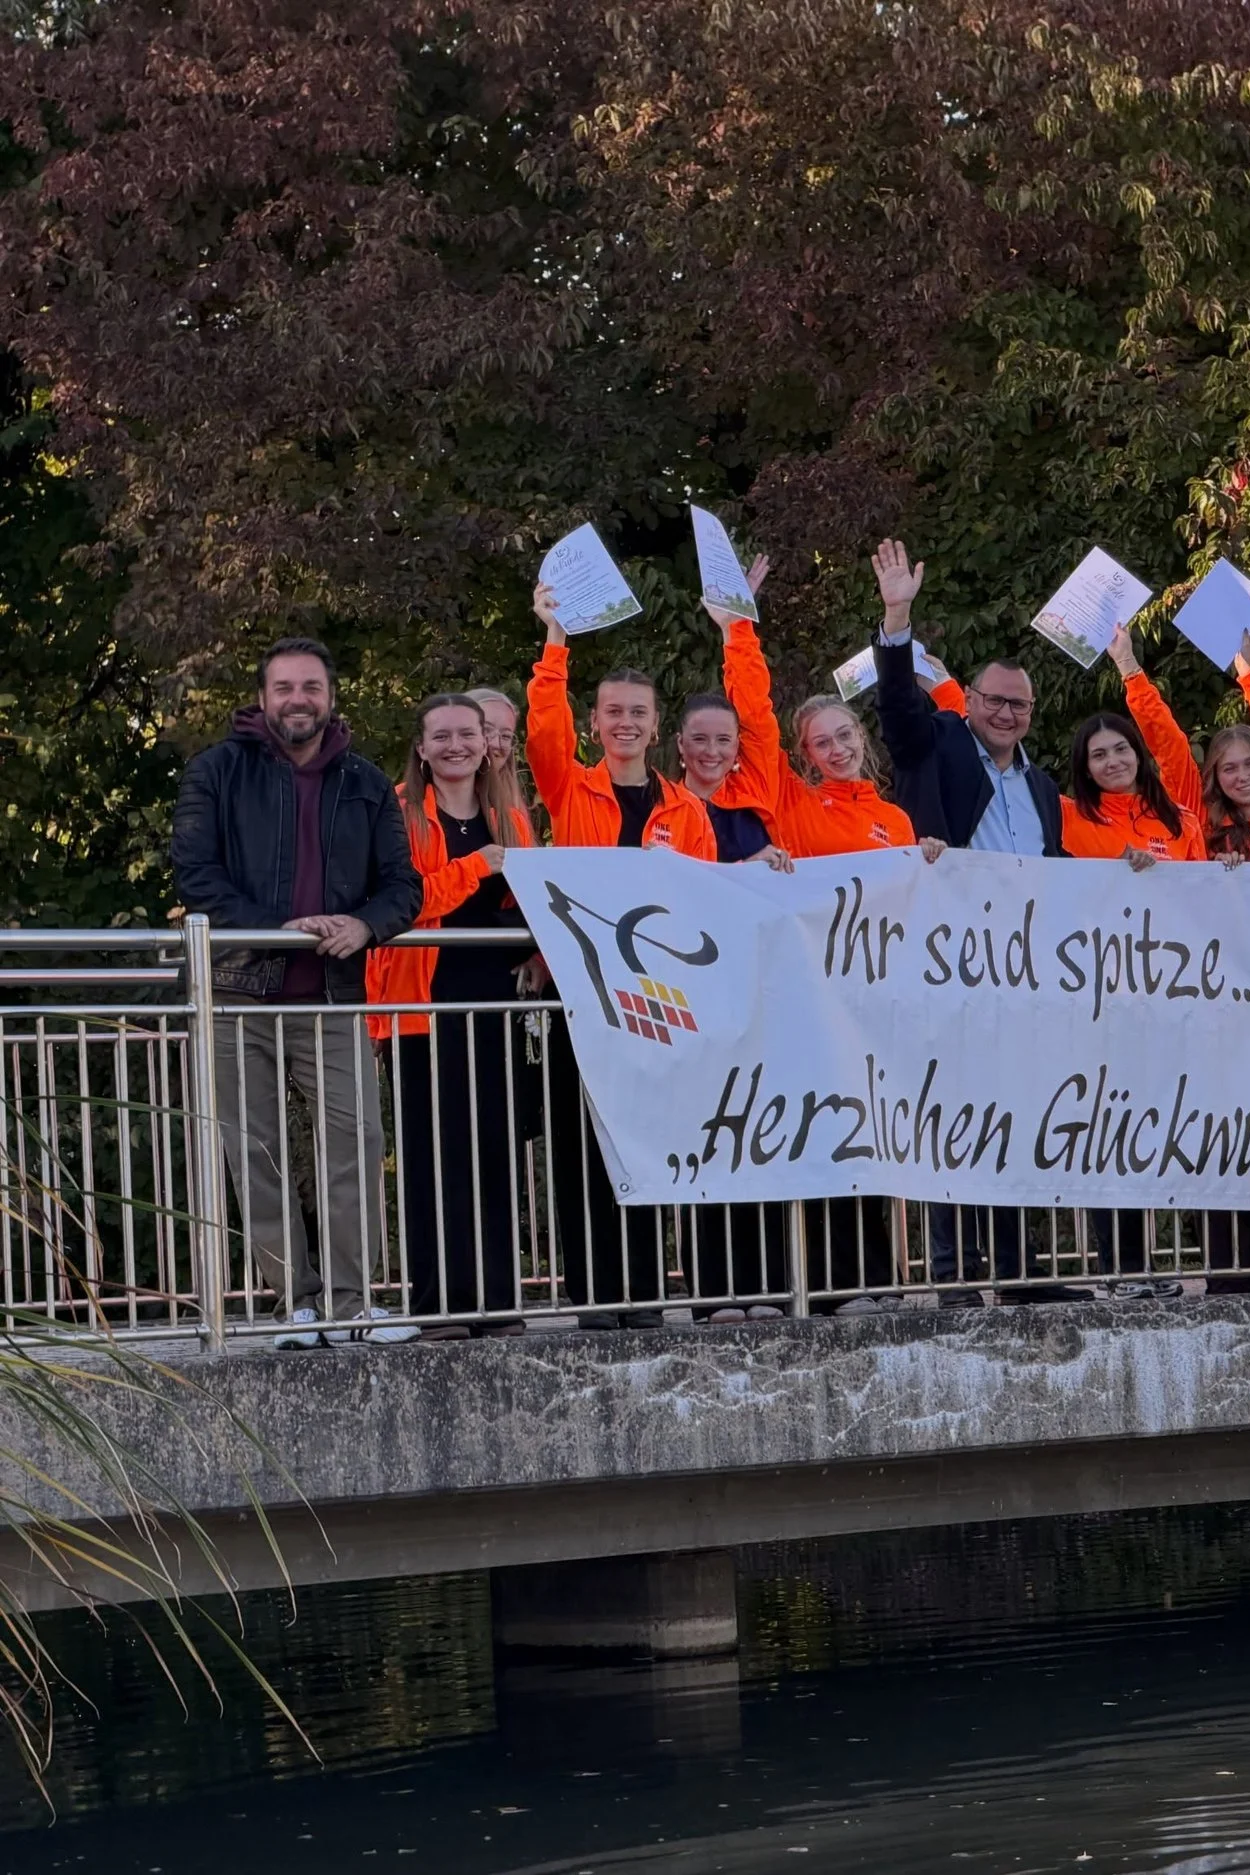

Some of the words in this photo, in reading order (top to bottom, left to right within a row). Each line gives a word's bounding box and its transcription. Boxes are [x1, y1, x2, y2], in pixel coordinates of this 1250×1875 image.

[824, 876, 905, 985] Ihr
[923, 898, 1040, 991] seid
[666, 1054, 1013, 1185] „Herzlichen
